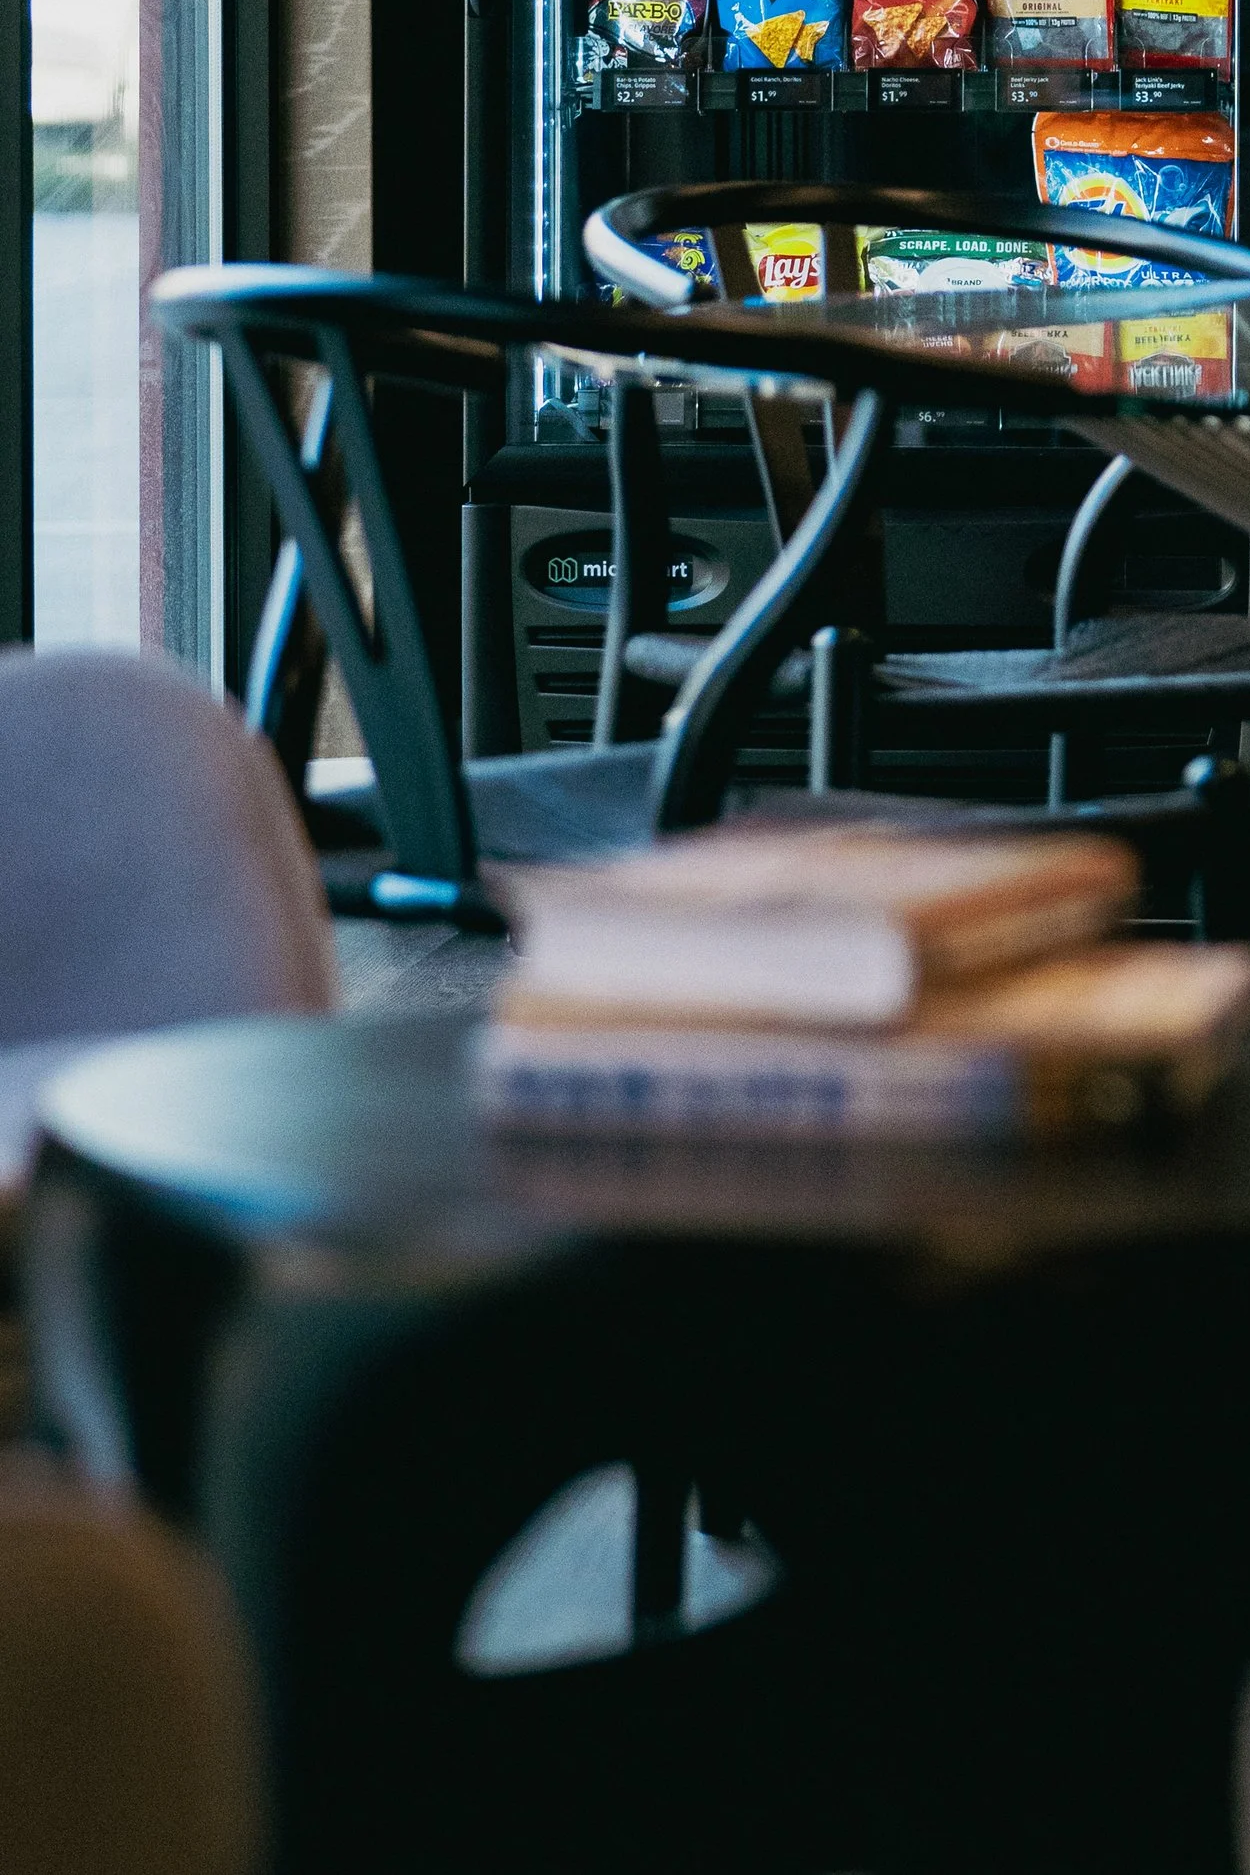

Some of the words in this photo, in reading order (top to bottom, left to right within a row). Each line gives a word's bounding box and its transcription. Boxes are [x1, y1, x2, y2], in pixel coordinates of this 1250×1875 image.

[608, 1, 683, 21] BAR-B-Q
[1022, 2, 1062, 11] ORIGINAL
[899, 240, 953, 252] SCRAPE.
[955, 241, 992, 252] LOAD.
[996, 241, 1032, 254] DONE.
[763, 254, 820, 288] Lay's
[1141, 271, 1192, 280] ULTRA
[583, 560, 688, 578] micrt
